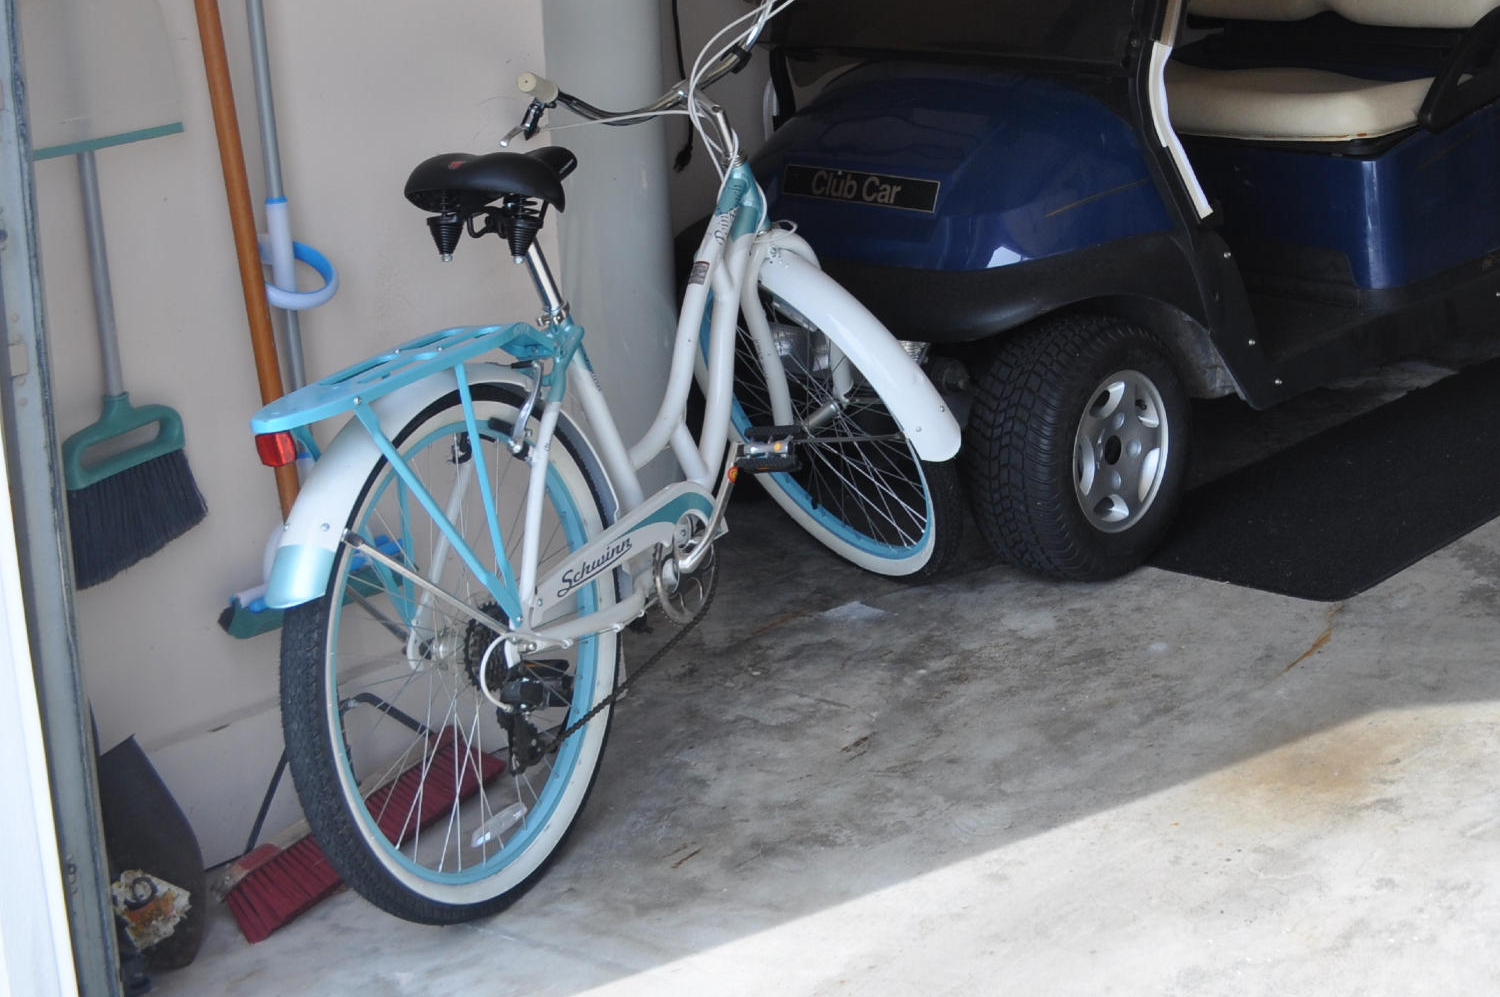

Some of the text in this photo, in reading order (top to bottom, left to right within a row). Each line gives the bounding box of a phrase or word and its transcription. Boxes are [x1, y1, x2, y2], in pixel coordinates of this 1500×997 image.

[811, 170, 902, 204] Club Car
[557, 537, 633, 598] Schwinn
